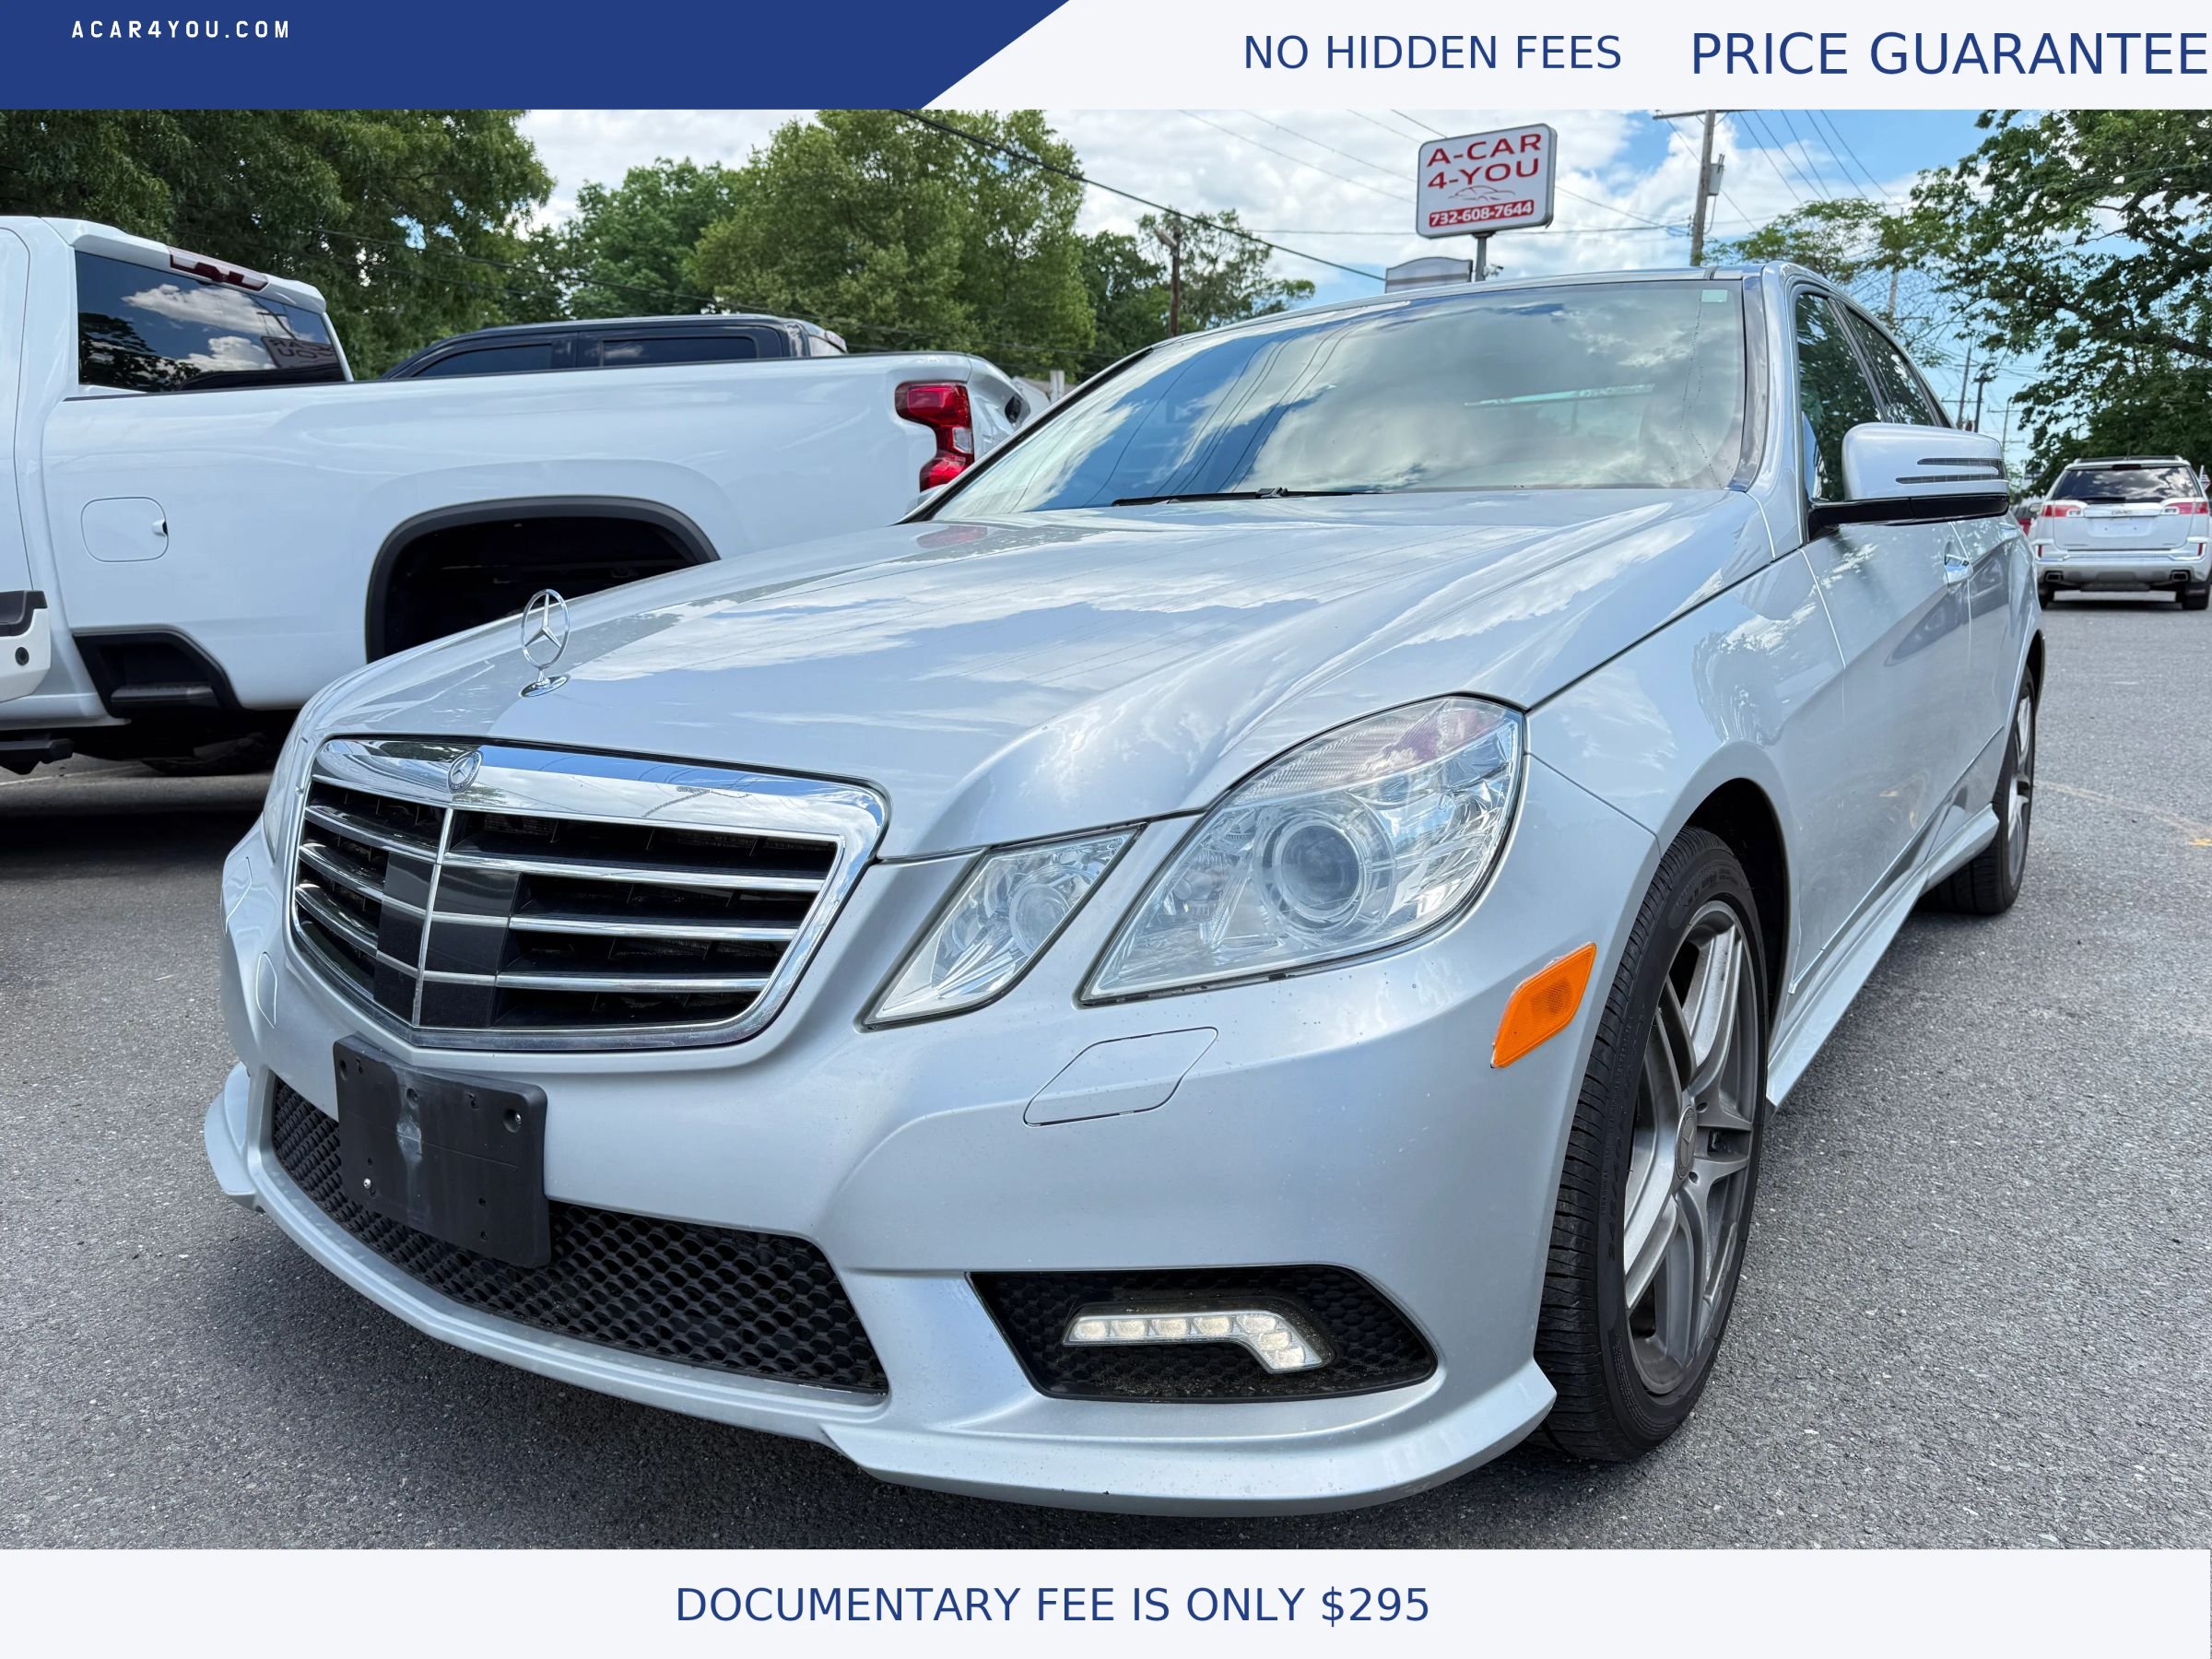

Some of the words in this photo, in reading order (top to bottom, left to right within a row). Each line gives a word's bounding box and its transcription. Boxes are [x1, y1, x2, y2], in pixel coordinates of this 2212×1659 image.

[1427, 133, 1542, 168] A-CAR
[1427, 158, 1539, 189] 4-YOU
[1430, 201, 1533, 226] 732-608-7644
